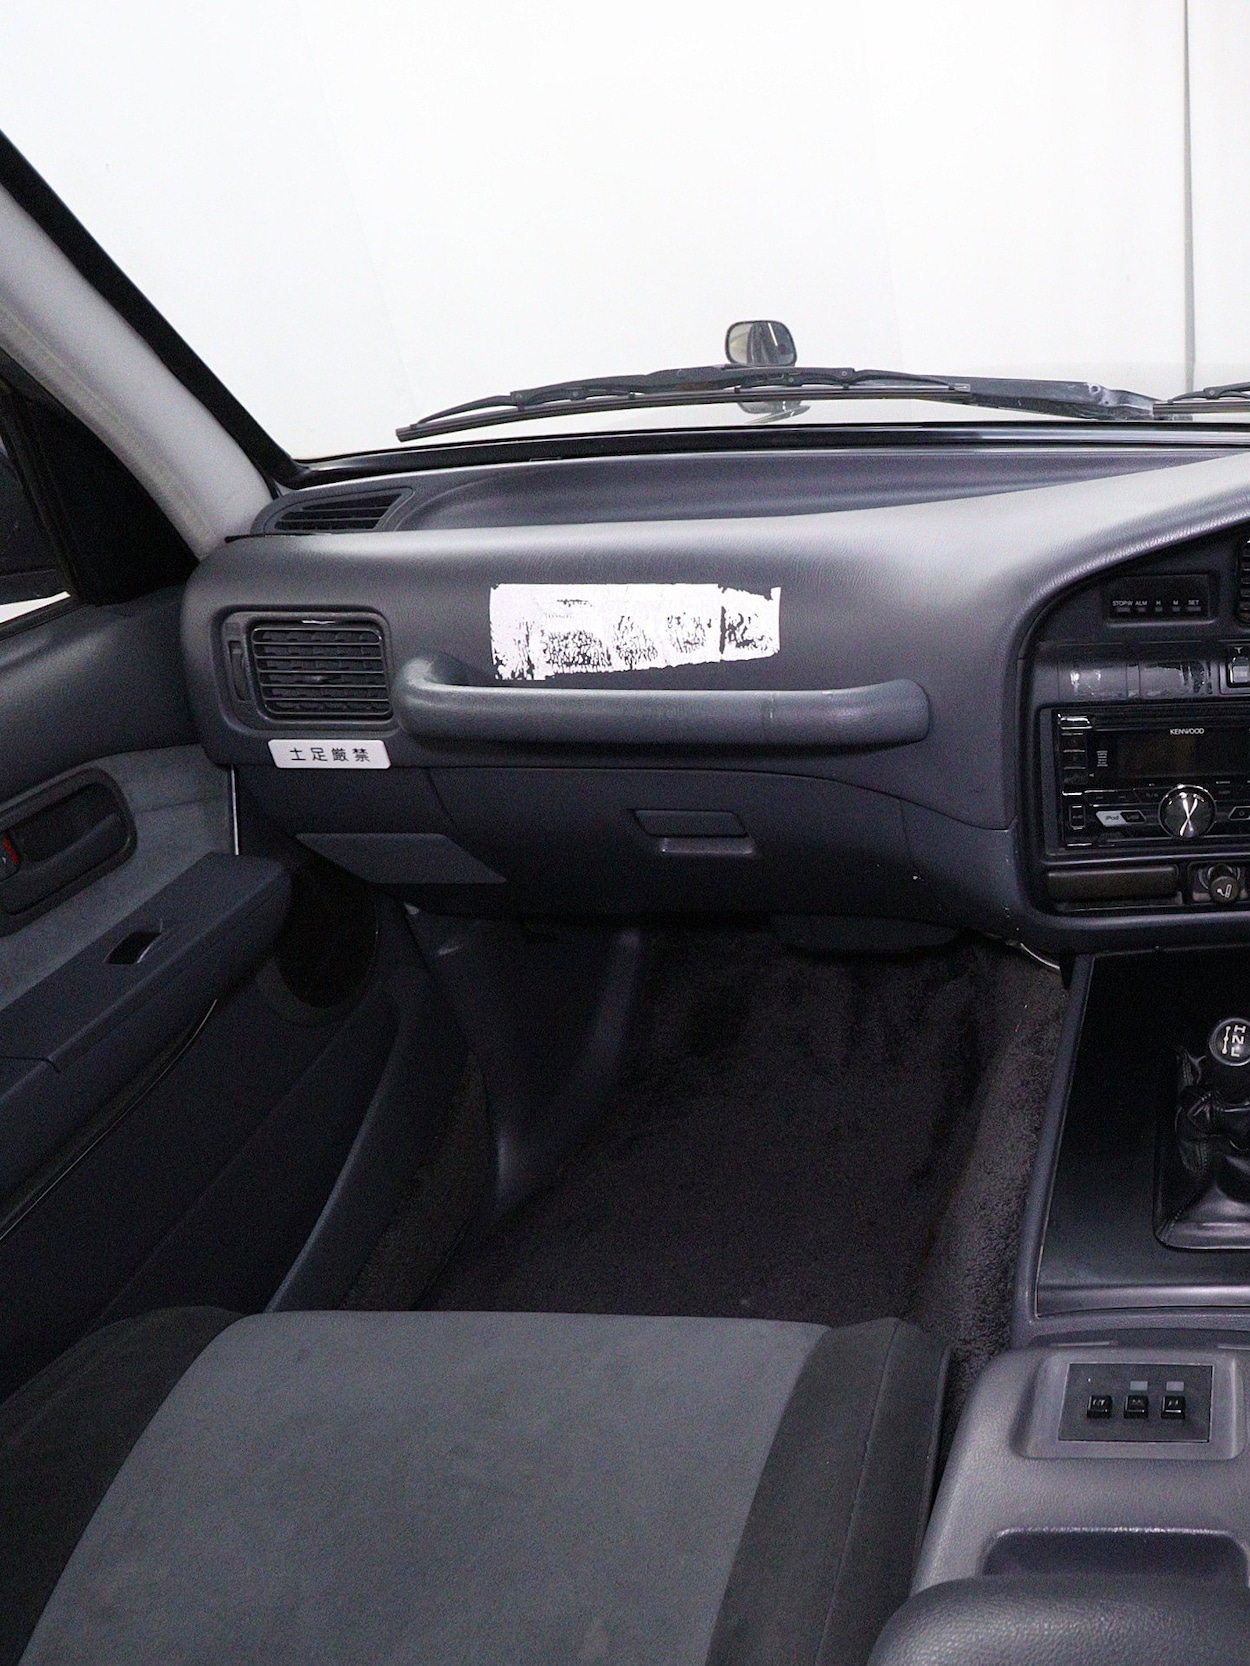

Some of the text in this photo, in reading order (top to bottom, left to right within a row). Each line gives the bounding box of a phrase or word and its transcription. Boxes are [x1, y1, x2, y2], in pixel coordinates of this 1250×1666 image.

[1169, 727, 1205, 735] KENWOOD
[289, 747, 370, 762] 土足厳禁
[1233, 1025, 1246, 1033] H
[1231, 1035, 1244, 1045] N
[1231, 1046, 1241, 1057] L
